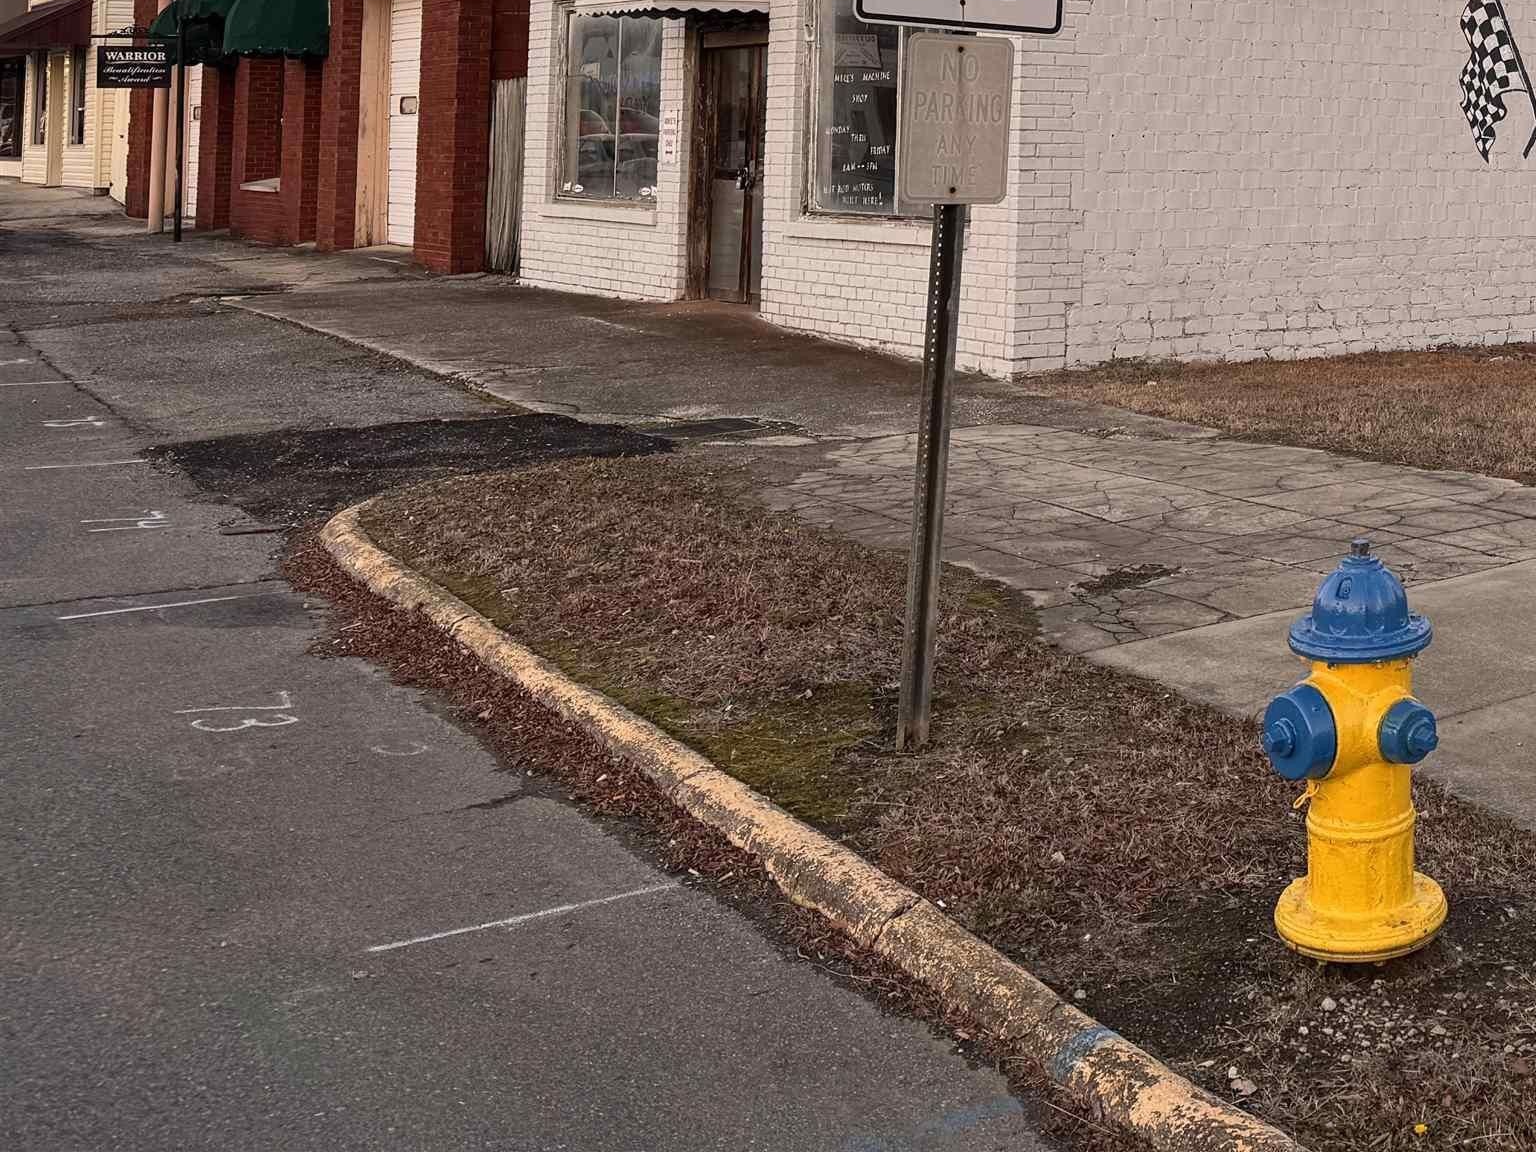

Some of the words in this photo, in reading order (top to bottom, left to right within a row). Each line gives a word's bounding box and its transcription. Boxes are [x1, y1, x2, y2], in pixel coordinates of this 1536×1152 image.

[105, 51, 166, 61] WARRIOR
[938, 52, 980, 82] NO
[913, 90, 1003, 123] PARKING
[936, 135, 977, 156] ANY
[931, 164, 979, 186] TIME
